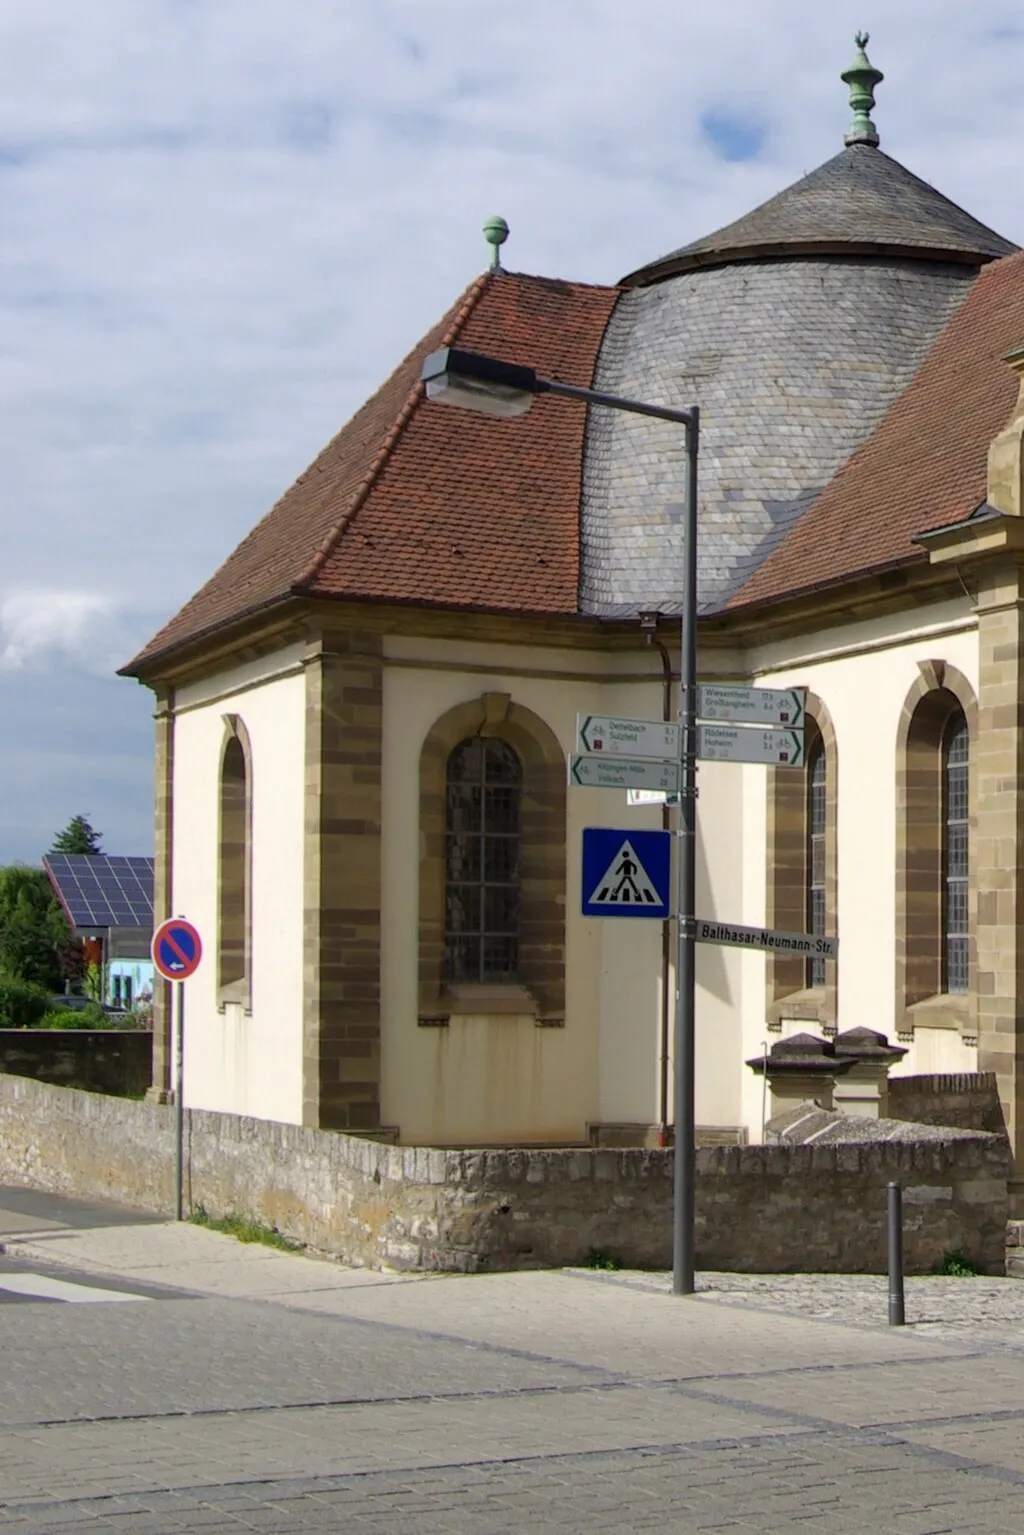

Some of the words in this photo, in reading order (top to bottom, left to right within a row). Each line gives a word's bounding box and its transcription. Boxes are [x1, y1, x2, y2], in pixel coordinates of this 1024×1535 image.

[705, 698, 756, 710] Großlangheim
[609, 721, 646, 733] Dettelbach
[609, 730, 638, 742] Sulzfeld
[705, 738, 733, 747] Hoheim
[598, 773, 625, 784] Volkach
[702, 924, 833, 954] Balthasar-Neumann-Str.
